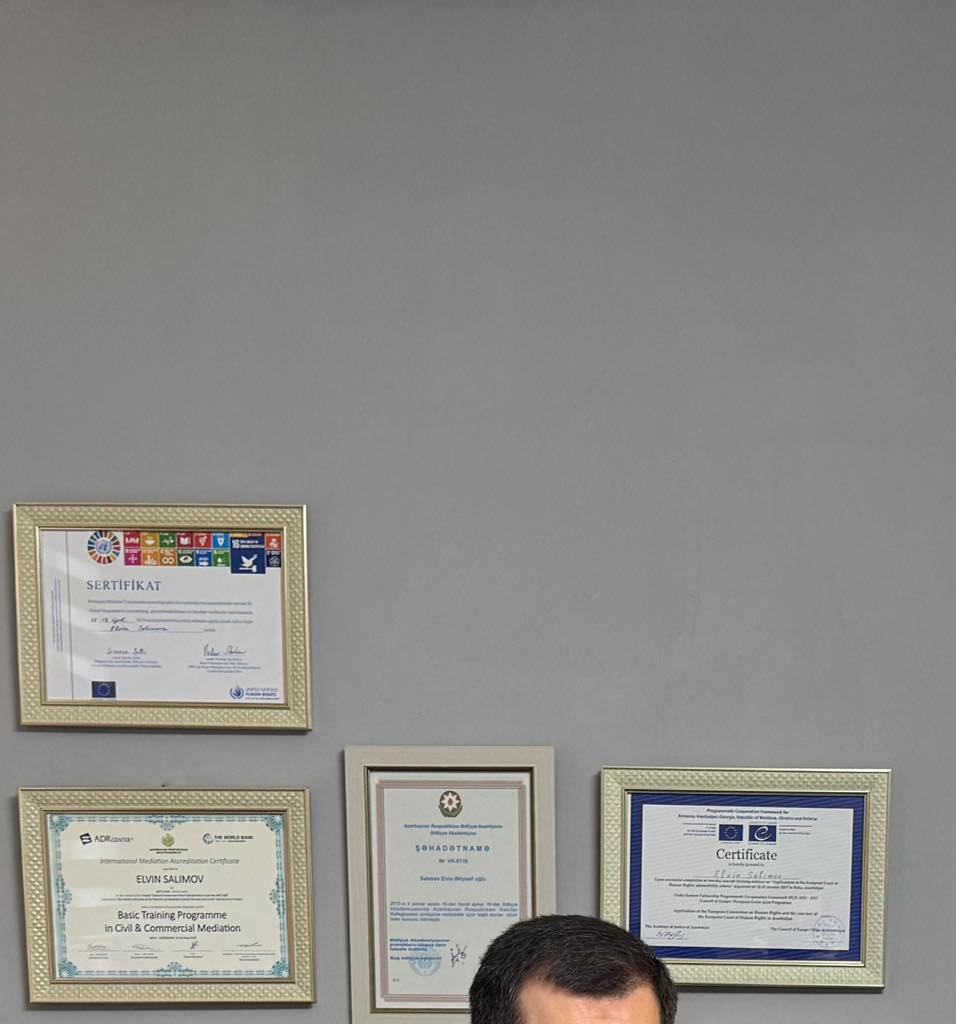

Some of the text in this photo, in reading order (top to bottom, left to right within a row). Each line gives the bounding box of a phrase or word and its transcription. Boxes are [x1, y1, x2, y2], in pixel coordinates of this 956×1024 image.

[86, 578, 162, 591] SERTİFİKAT
[716, 848, 778, 861] Certificate
[136, 874, 205, 884] ELVIN SALIMOV
[117, 911, 227, 921] Basic Training Programme
[104, 924, 241, 933] in Civil & Commercial Mediation
